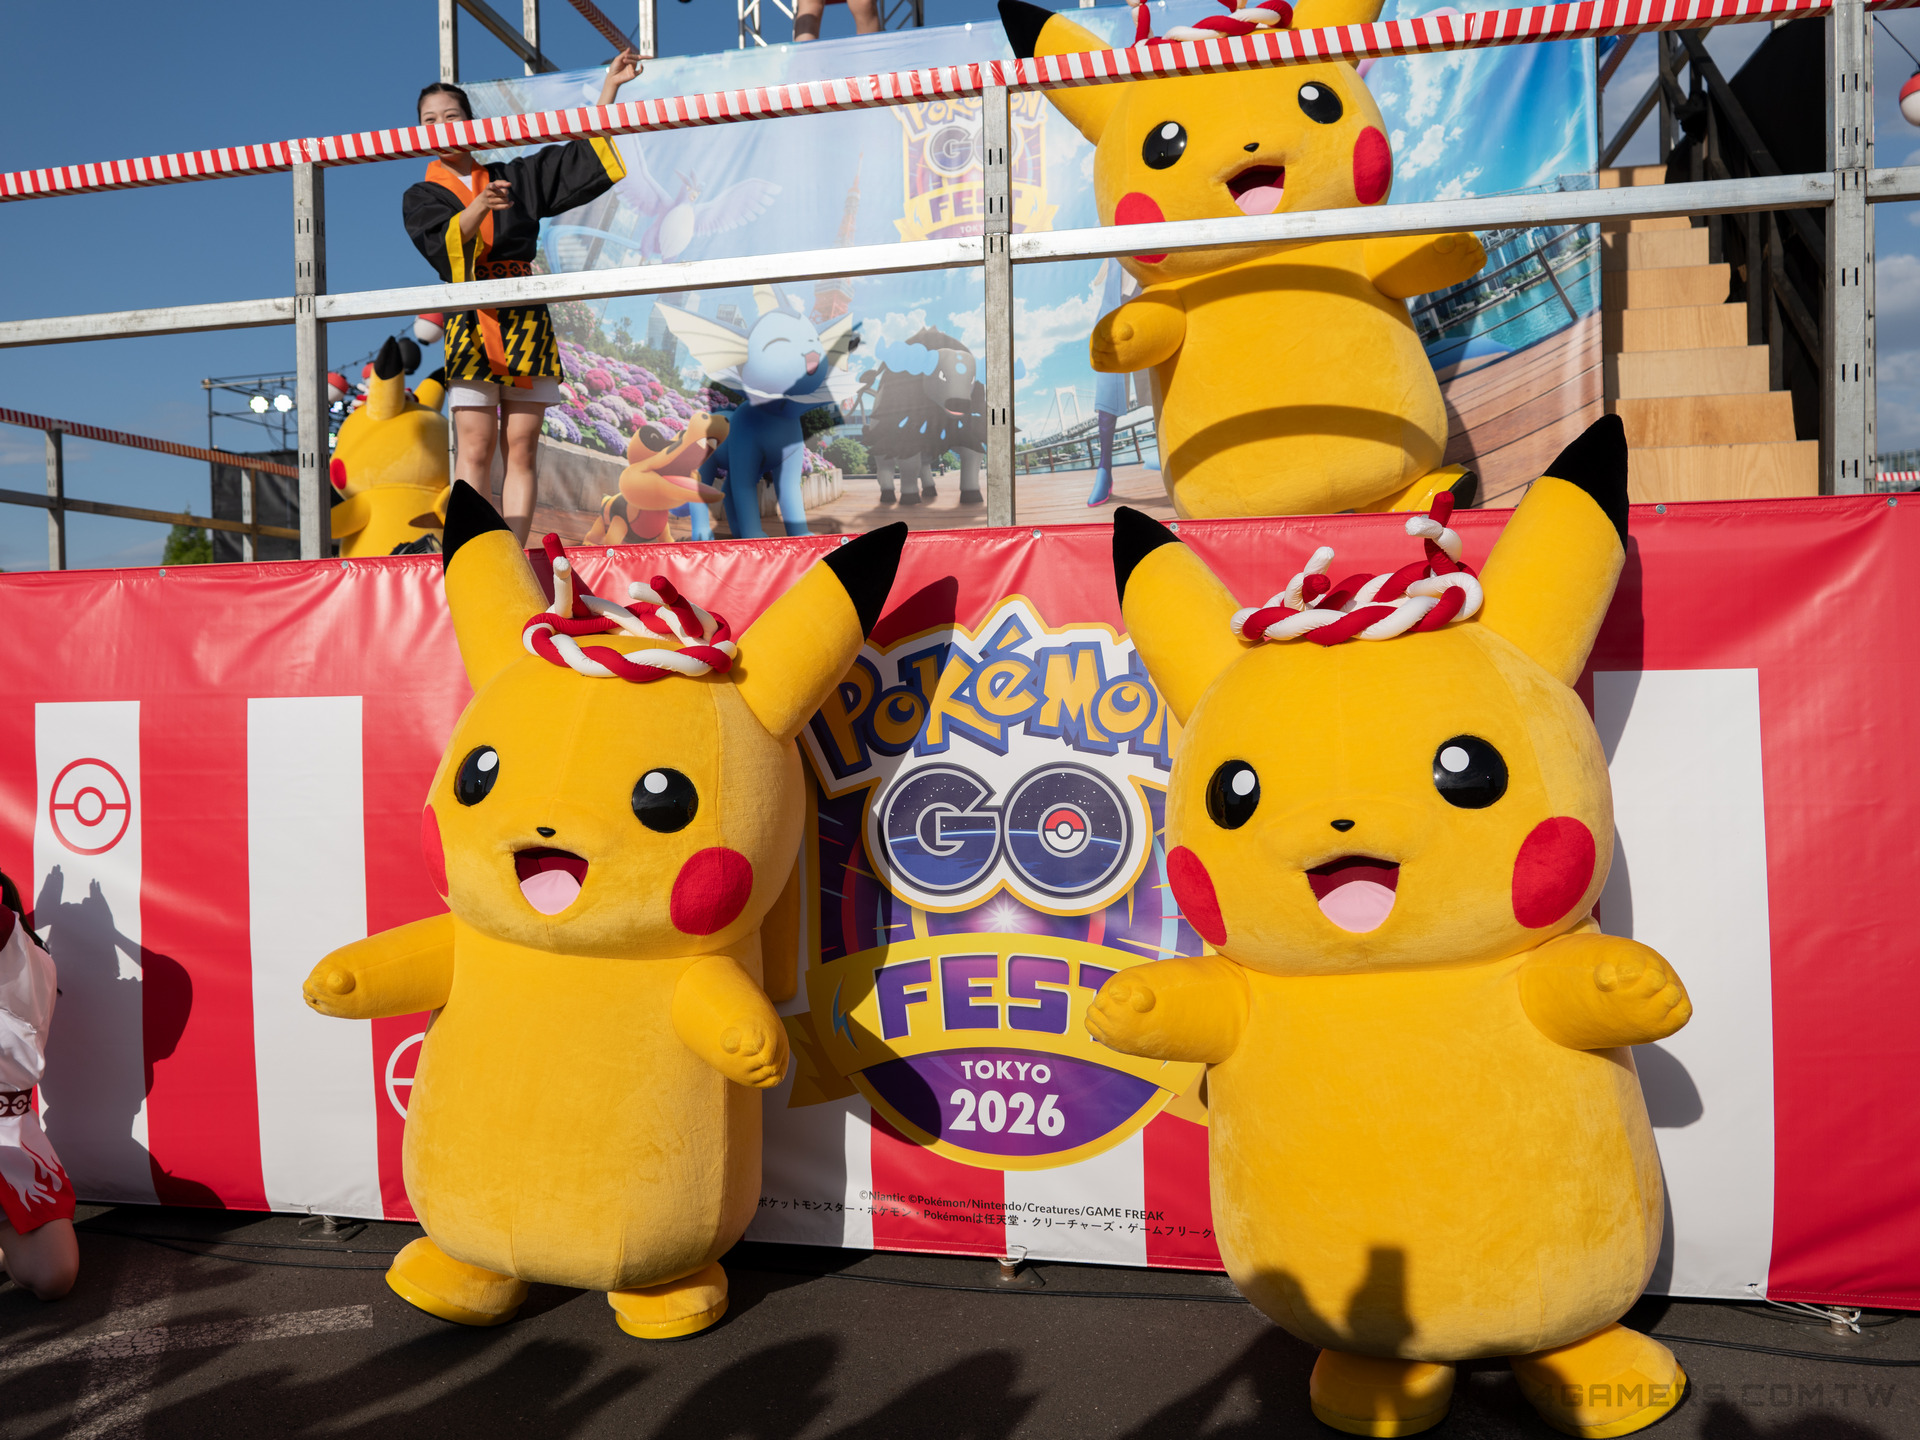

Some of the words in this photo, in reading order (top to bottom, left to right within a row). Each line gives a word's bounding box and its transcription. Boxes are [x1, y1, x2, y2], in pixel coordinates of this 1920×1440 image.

[879, 761, 1137, 899] GO
[961, 1060, 1051, 1084] TOKYO
[949, 1089, 1065, 1136] 2026
[859, 1190, 905, 1203] ©Niantic
[1125, 1209, 1165, 1221] FREAK
